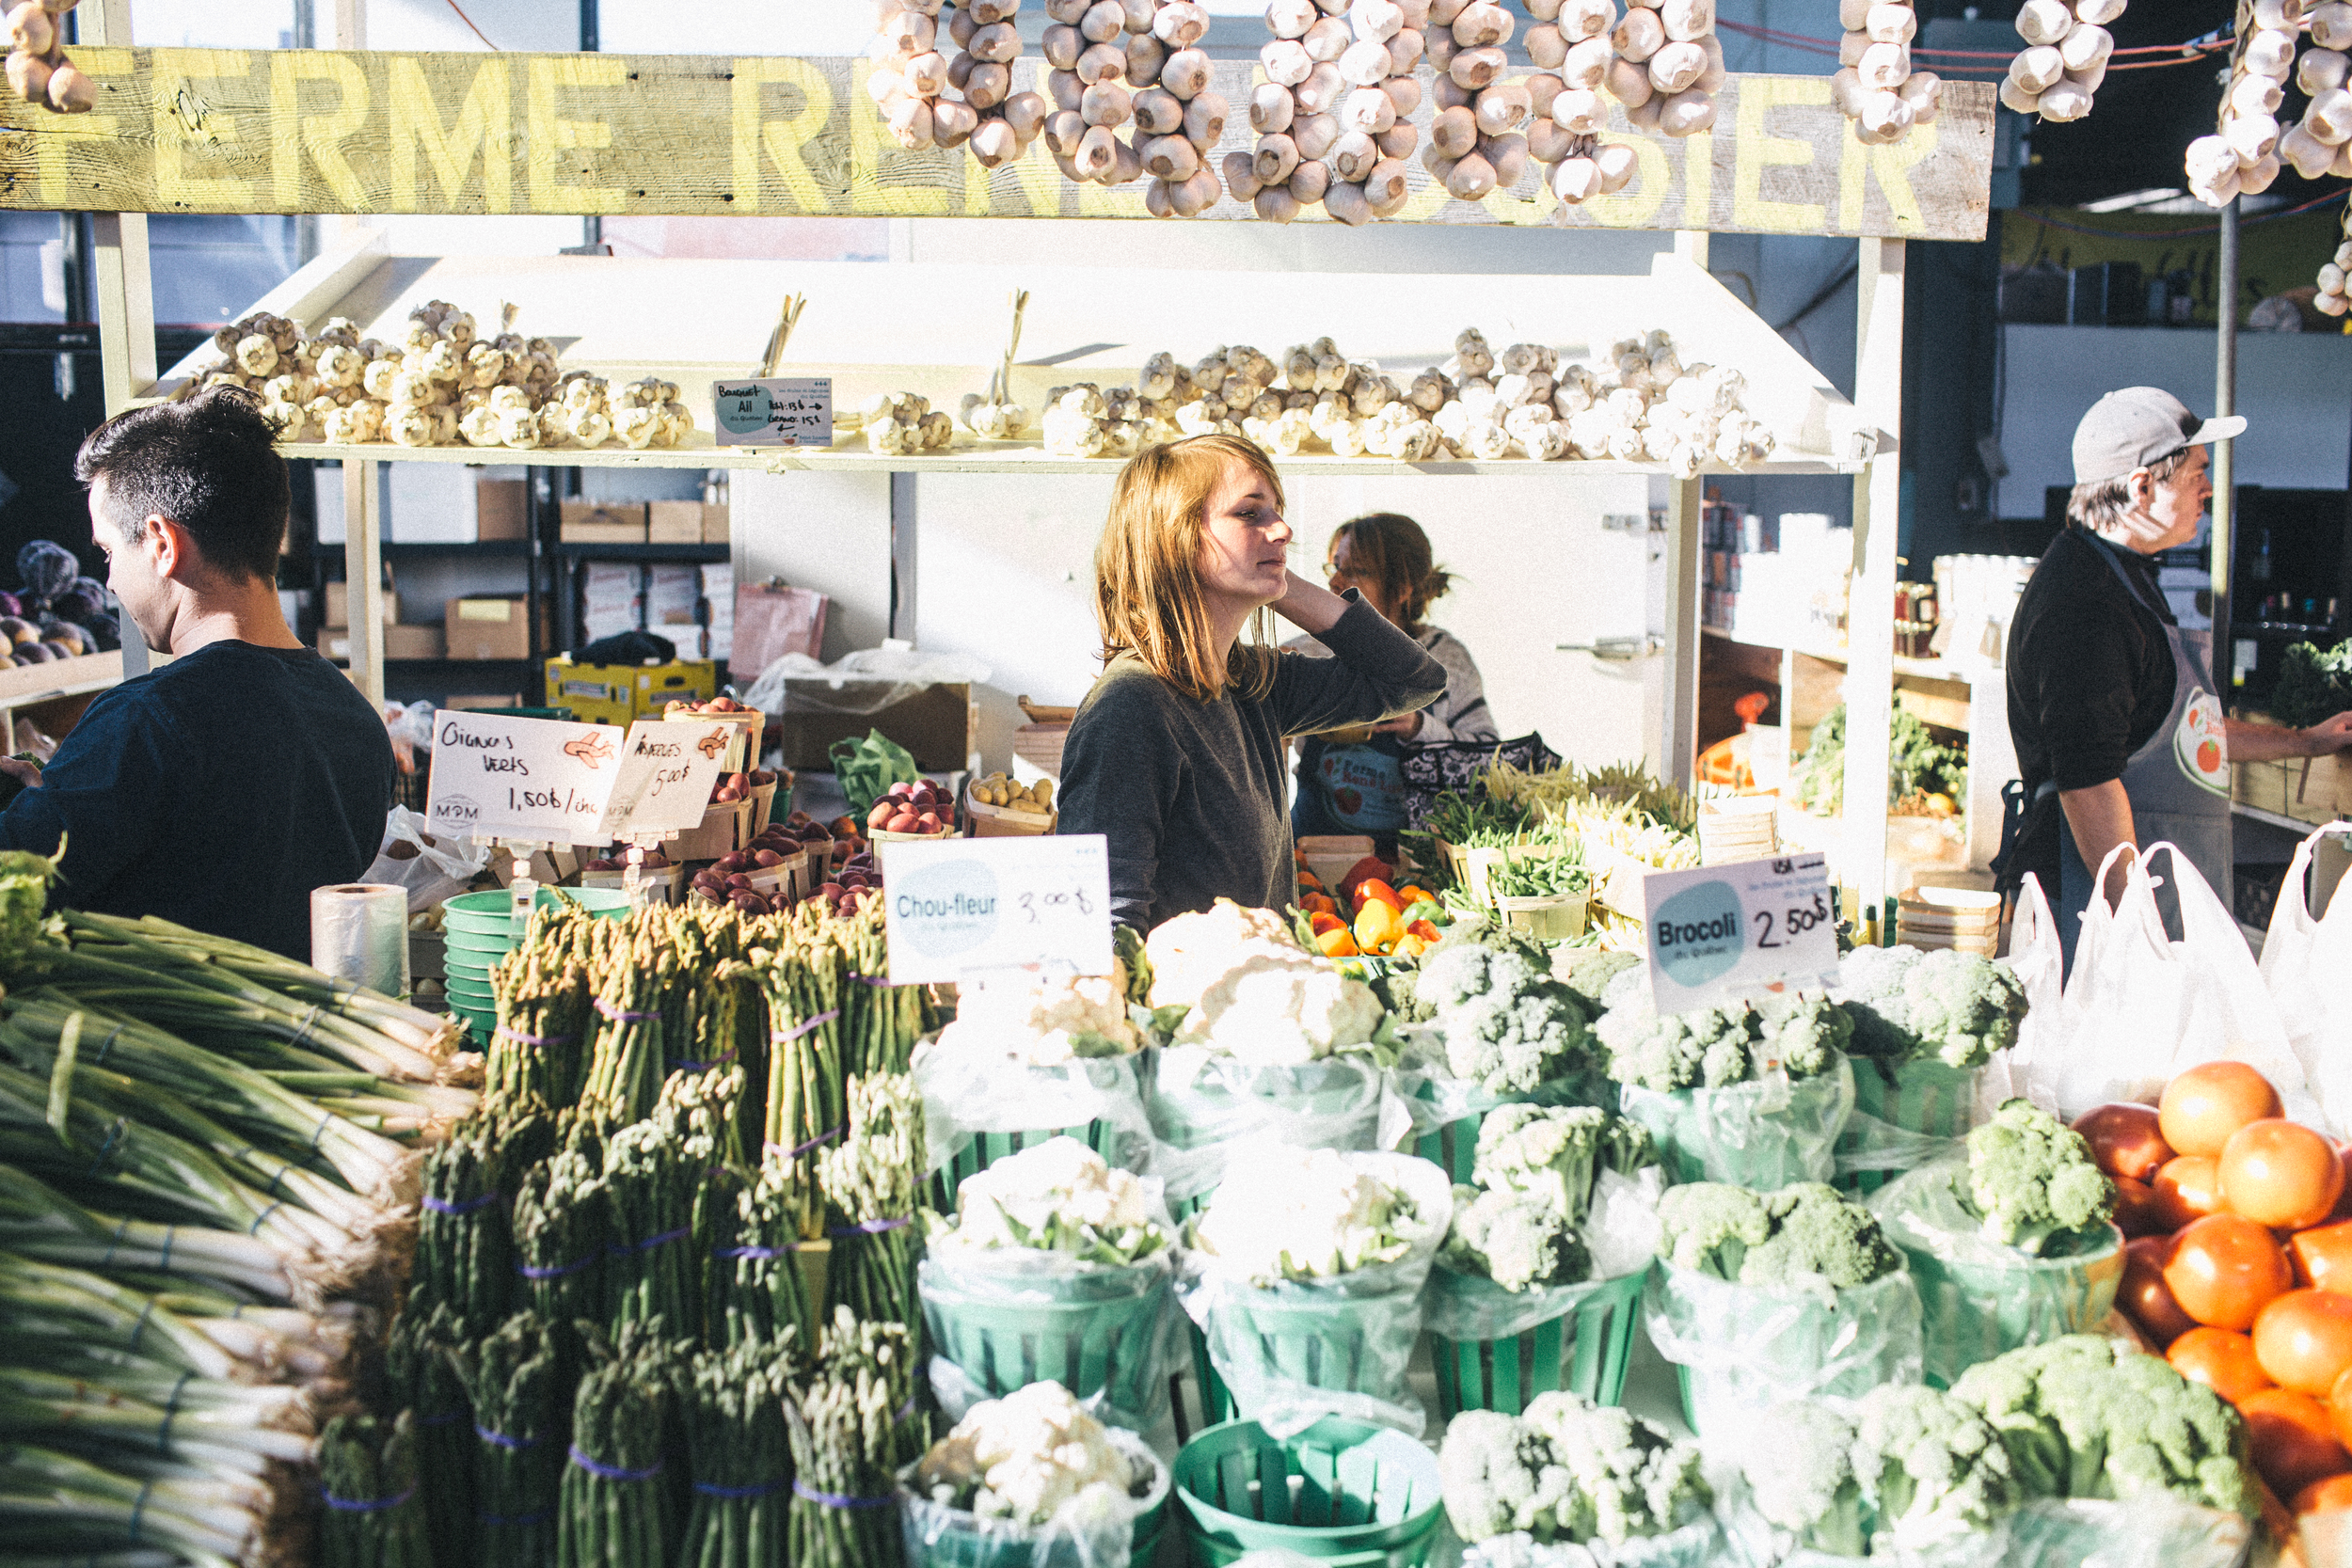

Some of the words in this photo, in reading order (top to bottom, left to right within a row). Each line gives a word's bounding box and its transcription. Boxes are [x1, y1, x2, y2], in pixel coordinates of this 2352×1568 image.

[34, 47, 628, 214] FERME
[738, 401, 753, 413] Ail
[897, 893, 997, 918] Chou-fleur
[1658, 911, 1737, 947] Brocoli
